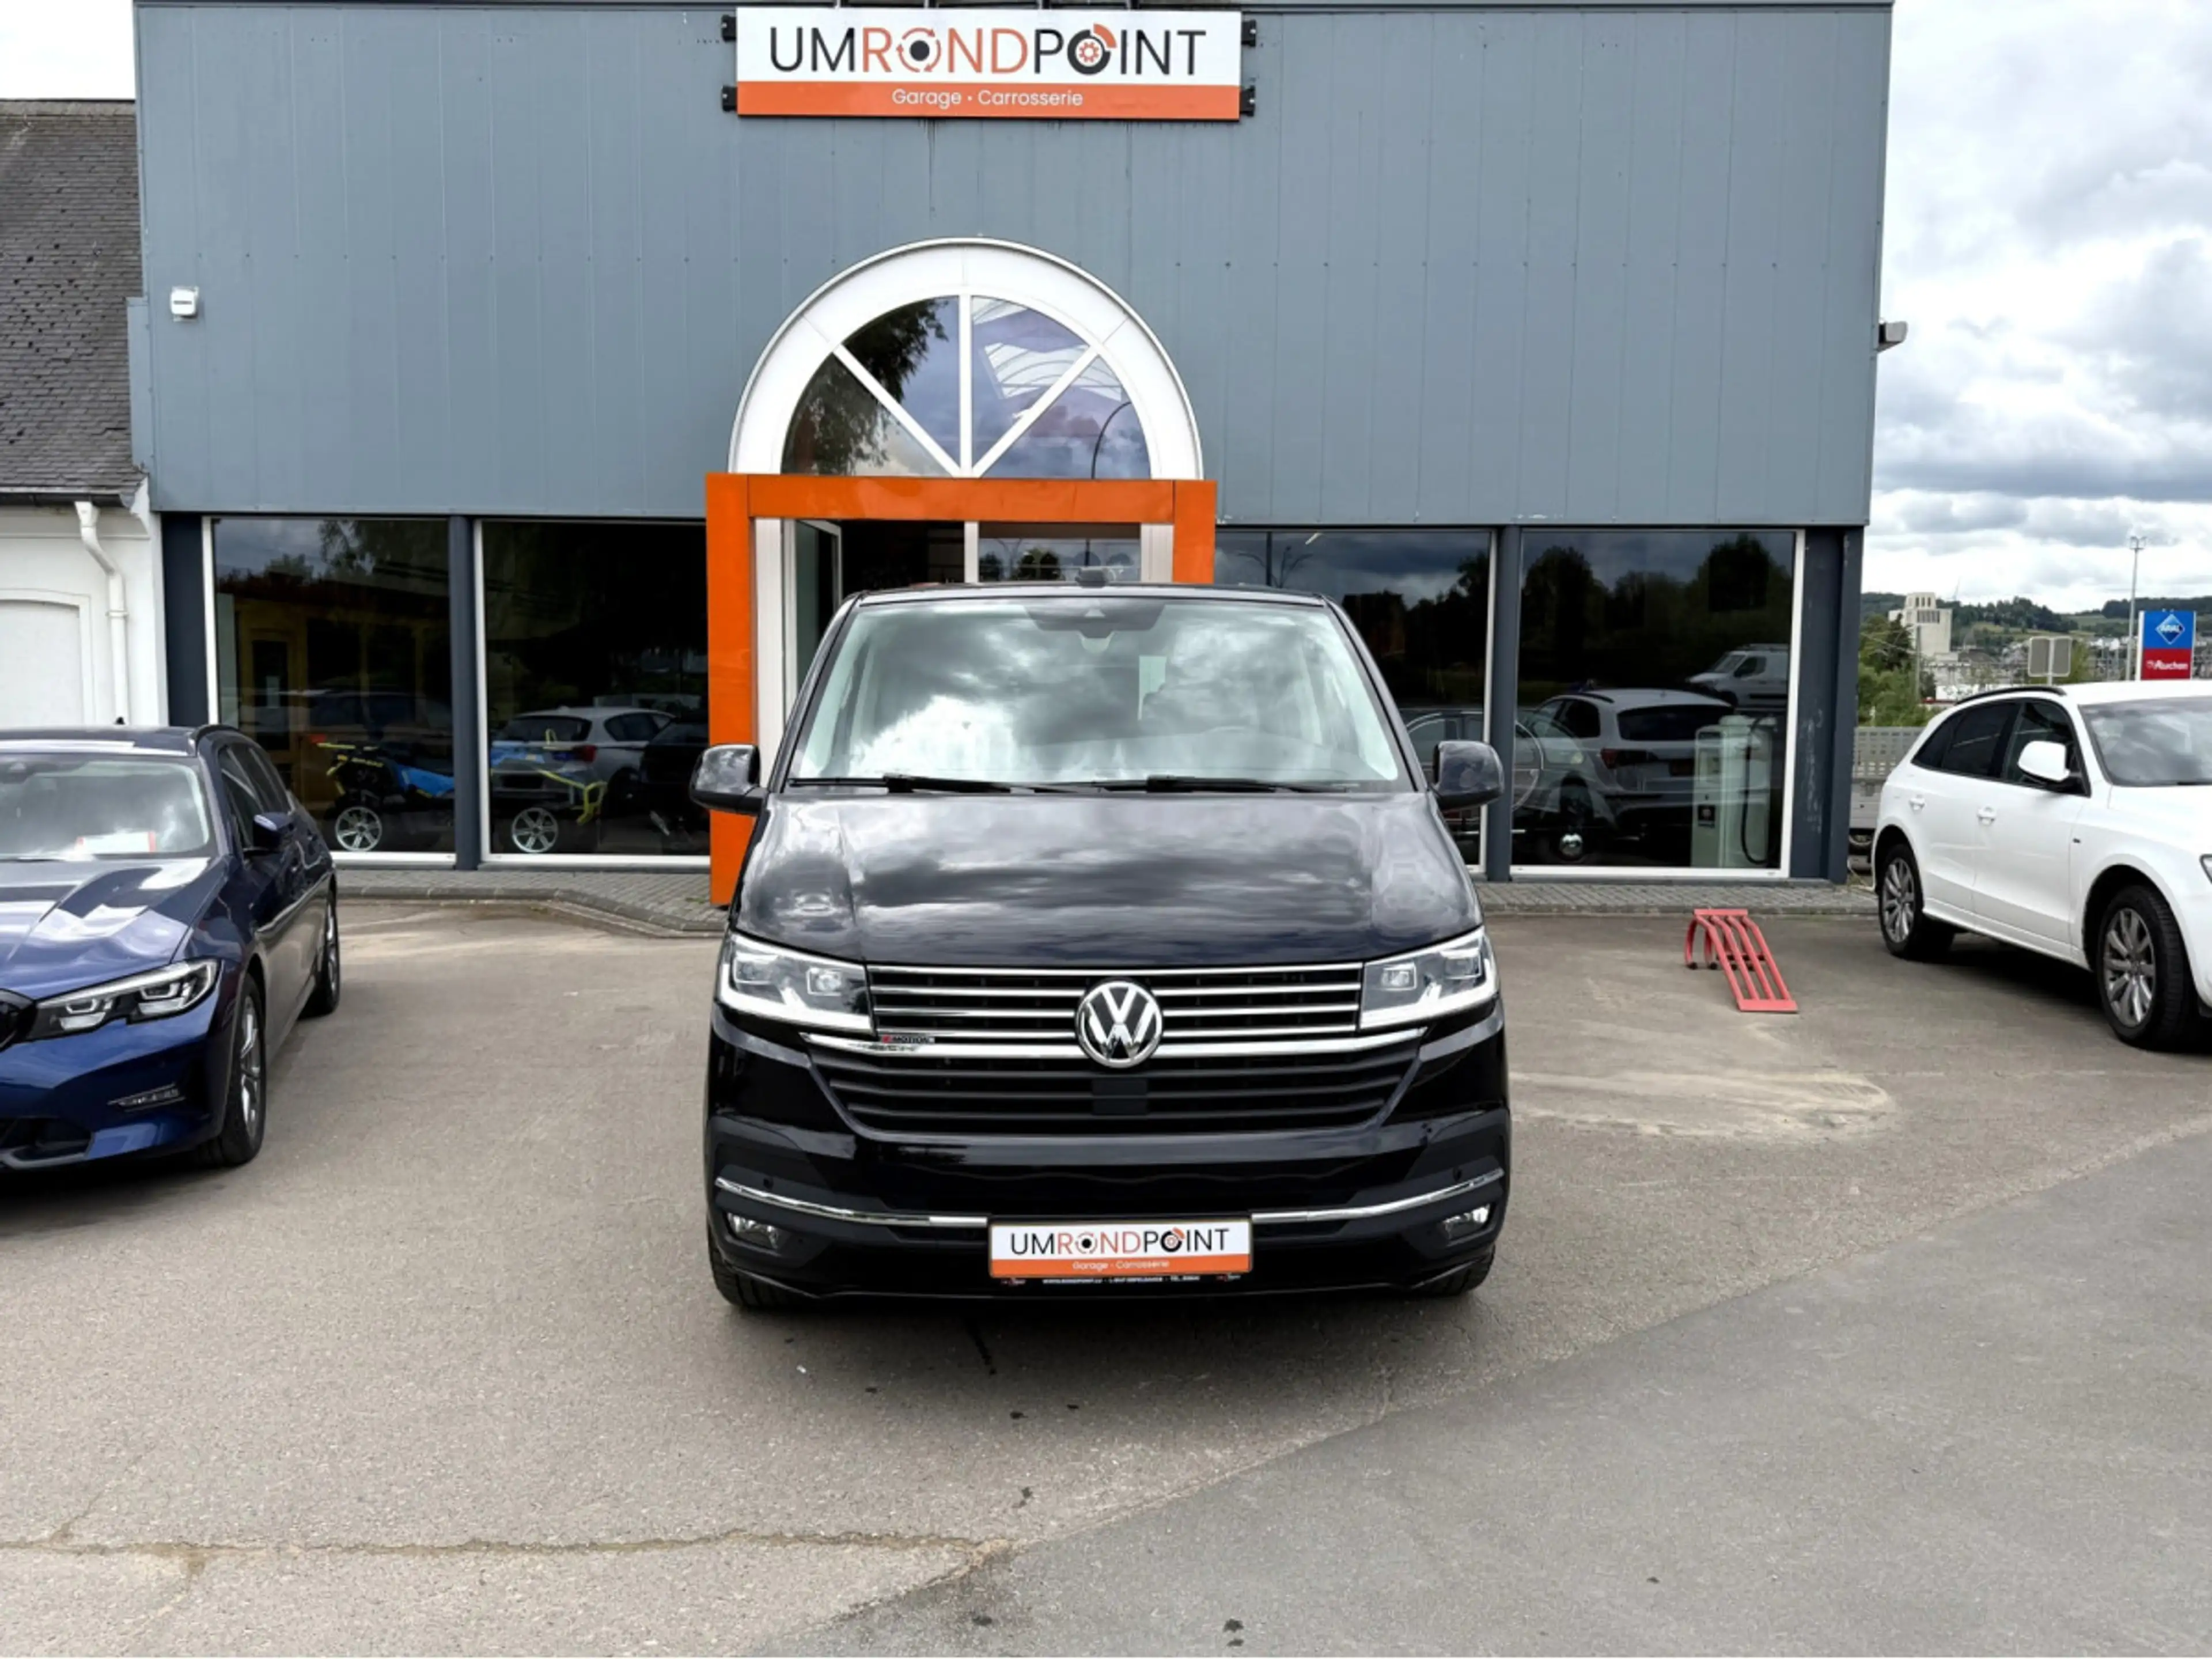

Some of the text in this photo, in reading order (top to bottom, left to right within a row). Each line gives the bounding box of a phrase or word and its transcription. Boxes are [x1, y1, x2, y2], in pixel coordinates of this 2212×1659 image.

[770, 24, 1206, 75] UMRONDPOINT
[892, 88, 1083, 107] Garage Carrosserie
[1011, 1227, 1229, 1255] UMRONDPOINT
[1072, 1261, 1108, 1272] Garage
